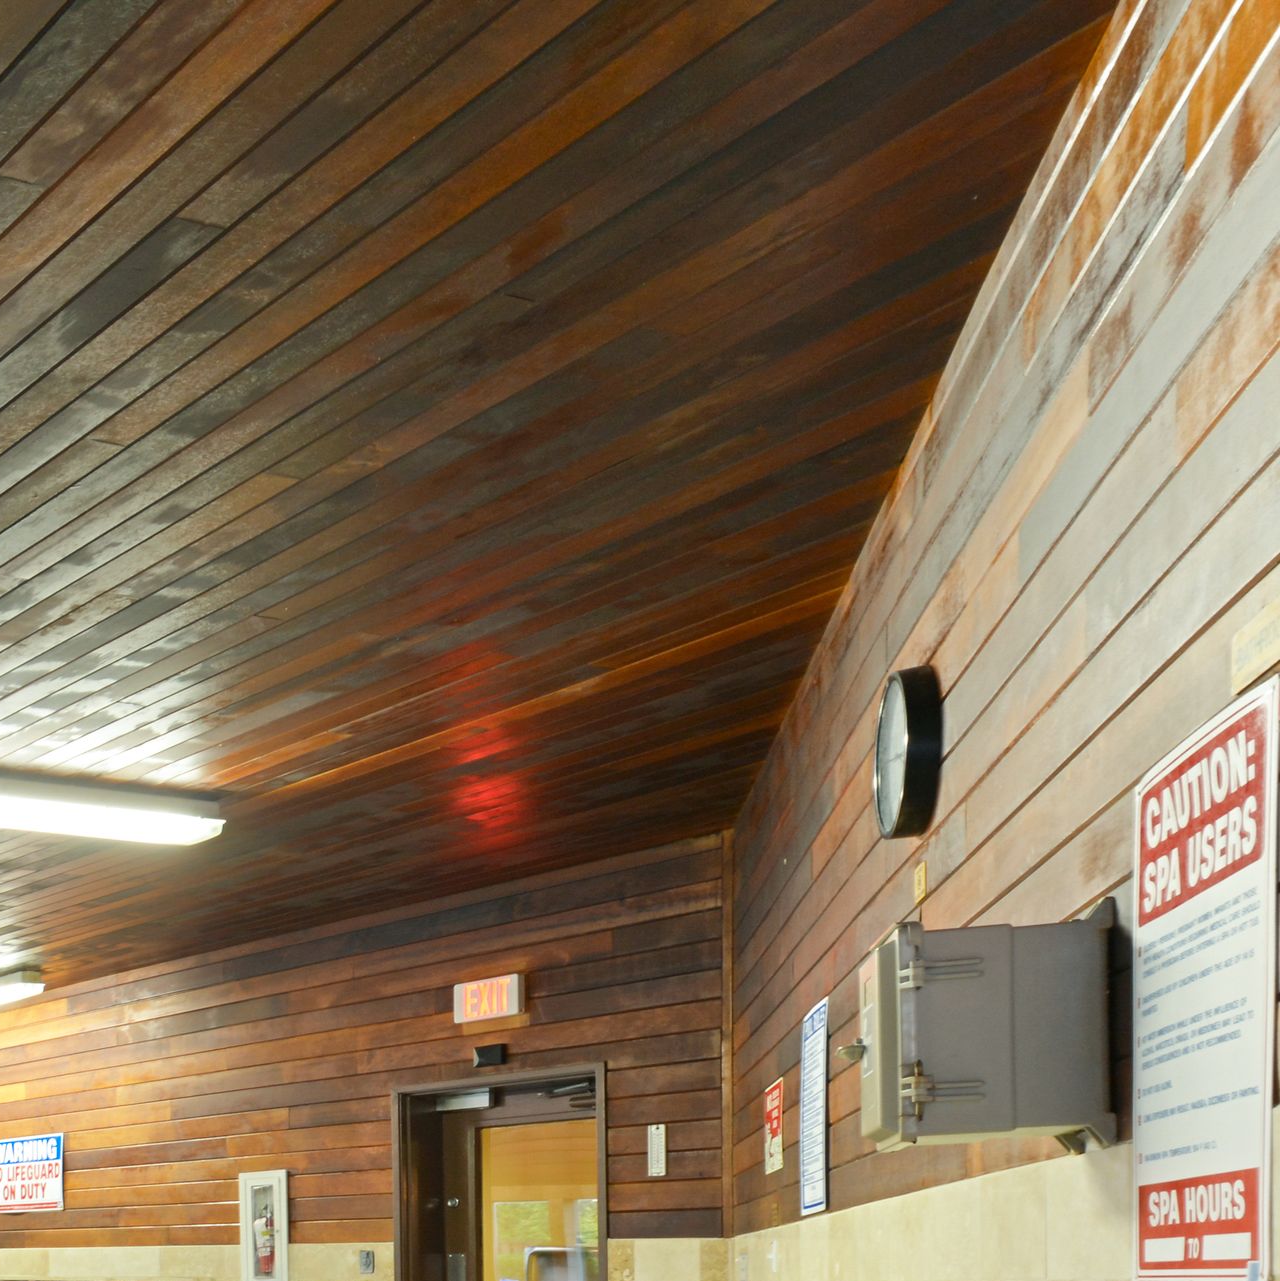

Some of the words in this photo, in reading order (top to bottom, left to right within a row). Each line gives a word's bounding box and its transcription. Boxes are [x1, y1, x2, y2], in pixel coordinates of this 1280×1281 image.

[1146, 730, 1255, 849] CAUTION:
[1143, 847, 1181, 912] SPA
[1187, 796, 1257, 888] USERS
[465, 978, 511, 1018] EXIT
[3, 1185, 16, 1201] ON
[21, 1182, 47, 1200] DUTY
[7, 1162, 60, 1182] LIFEGUARD
[1149, 1189, 1180, 1227] SPA
[1184, 1179, 1246, 1223] HOURS
[1187, 1236, 1200, 1259] TO
